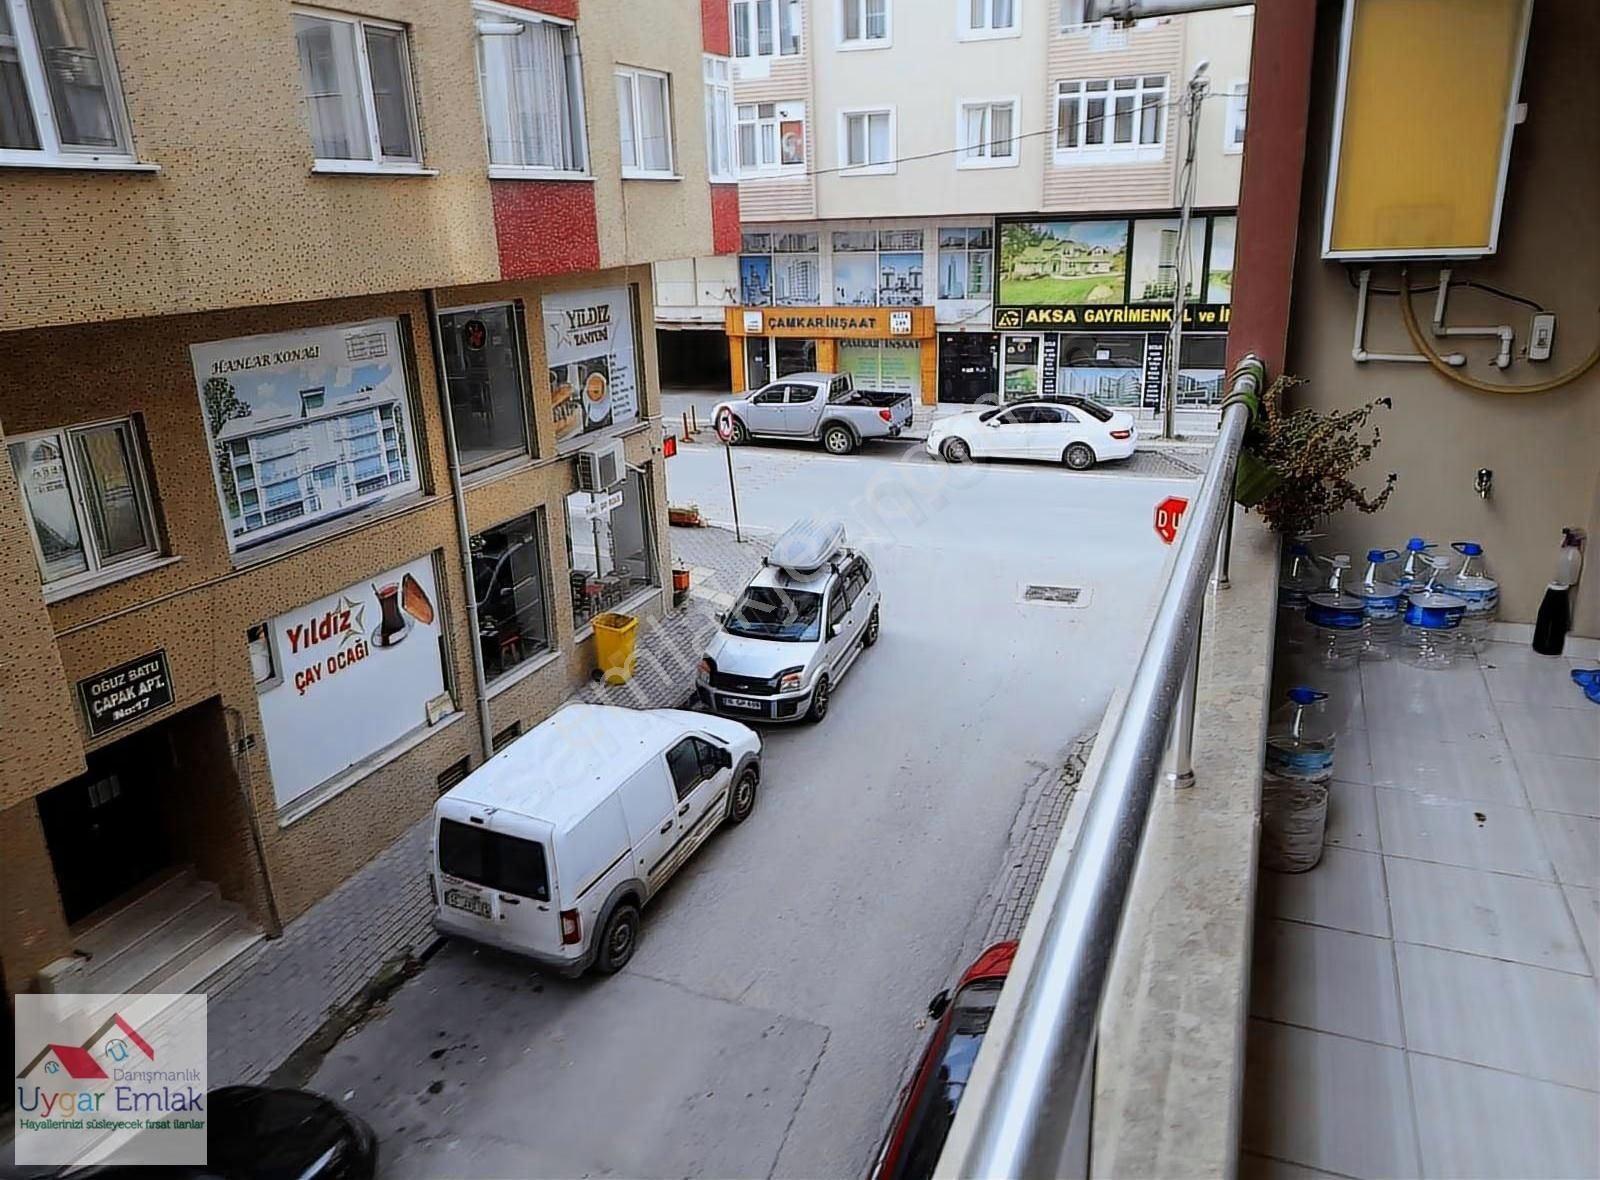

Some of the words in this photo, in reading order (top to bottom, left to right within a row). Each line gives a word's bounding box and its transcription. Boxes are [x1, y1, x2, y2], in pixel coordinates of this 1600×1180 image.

[566, 304, 610, 329] YILDIZ
[1026, 309, 1076, 323] AKSA
[1084, 305, 1191, 323] GAYRİMENKL
[1199, 311, 1215, 322] ve
[212, 354, 271, 375] HANLAR
[286, 609, 352, 654] Yıldız
[295, 662, 322, 696] ÇAY
[327, 638, 370, 674] OCAĞI
[91, 674, 126, 696] OĞUZ
[93, 685, 136, 719] ÇAPAK
